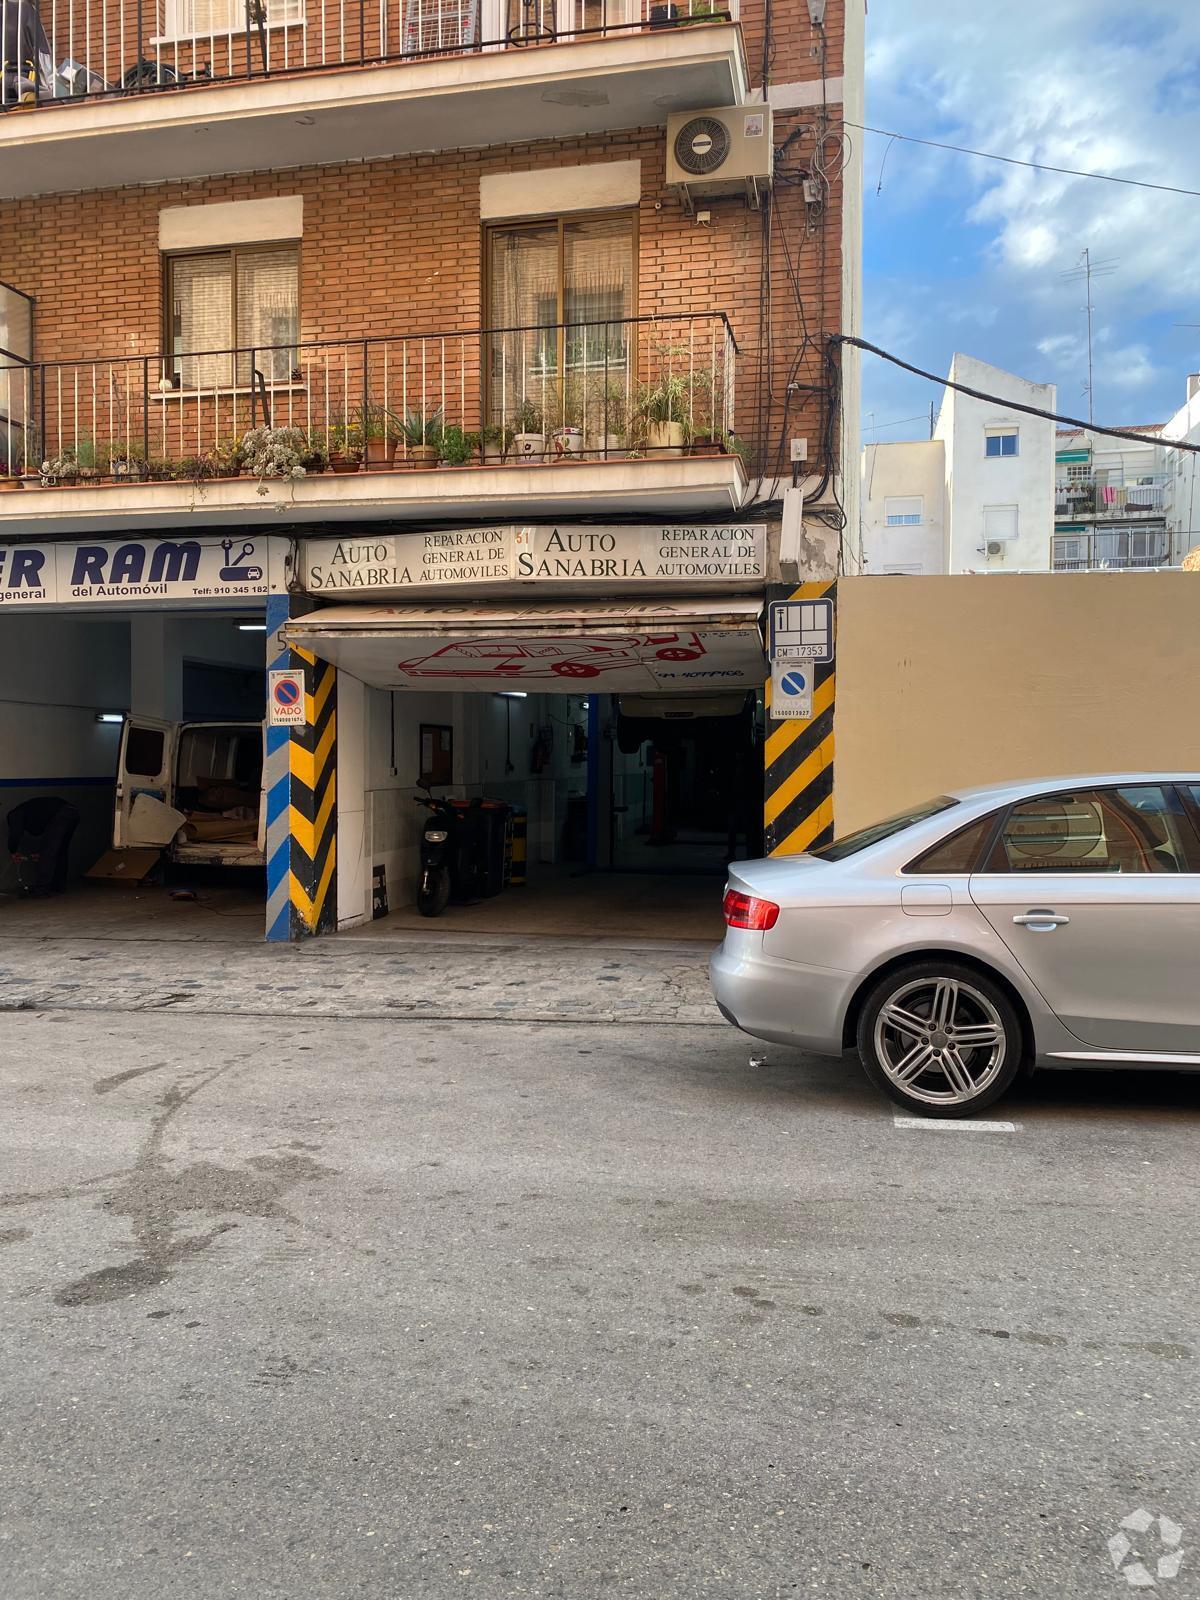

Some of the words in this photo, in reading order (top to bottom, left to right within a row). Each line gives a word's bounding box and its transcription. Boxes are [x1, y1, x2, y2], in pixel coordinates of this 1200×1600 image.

[423, 531, 503, 547] REPARACION
[515, 531, 529, 544] 51
[544, 528, 616, 552] AUTO
[661, 528, 755, 541] REPARACION
[331, 543, 388, 564] AUTO
[422, 549, 484, 565] GENERAL
[488, 548, 505, 560] DE
[659, 546, 732, 558] GENERAL
[737, 546, 756, 558] DE
[0, 549, 46, 588] R
[70, 541, 202, 585] RAM
[518, 552, 647, 577] SANABRIA
[655, 563, 761, 575] AUTOMOVILES
[310, 566, 413, 589] SANABRIA
[419, 564, 509, 581] AUTOMOVILES
[72, 587, 93, 597] del
[96, 584, 168, 596] Automóvil
[192, 587, 212, 595] Telf:
[214, 586, 231, 594] 910
[233, 586, 249, 594] 345
[252, 585, 268, 593] 182
[368, 607, 470, 615] AUTO
[796, 646, 823, 657] 17353
[274, 706, 302, 715] VADO
